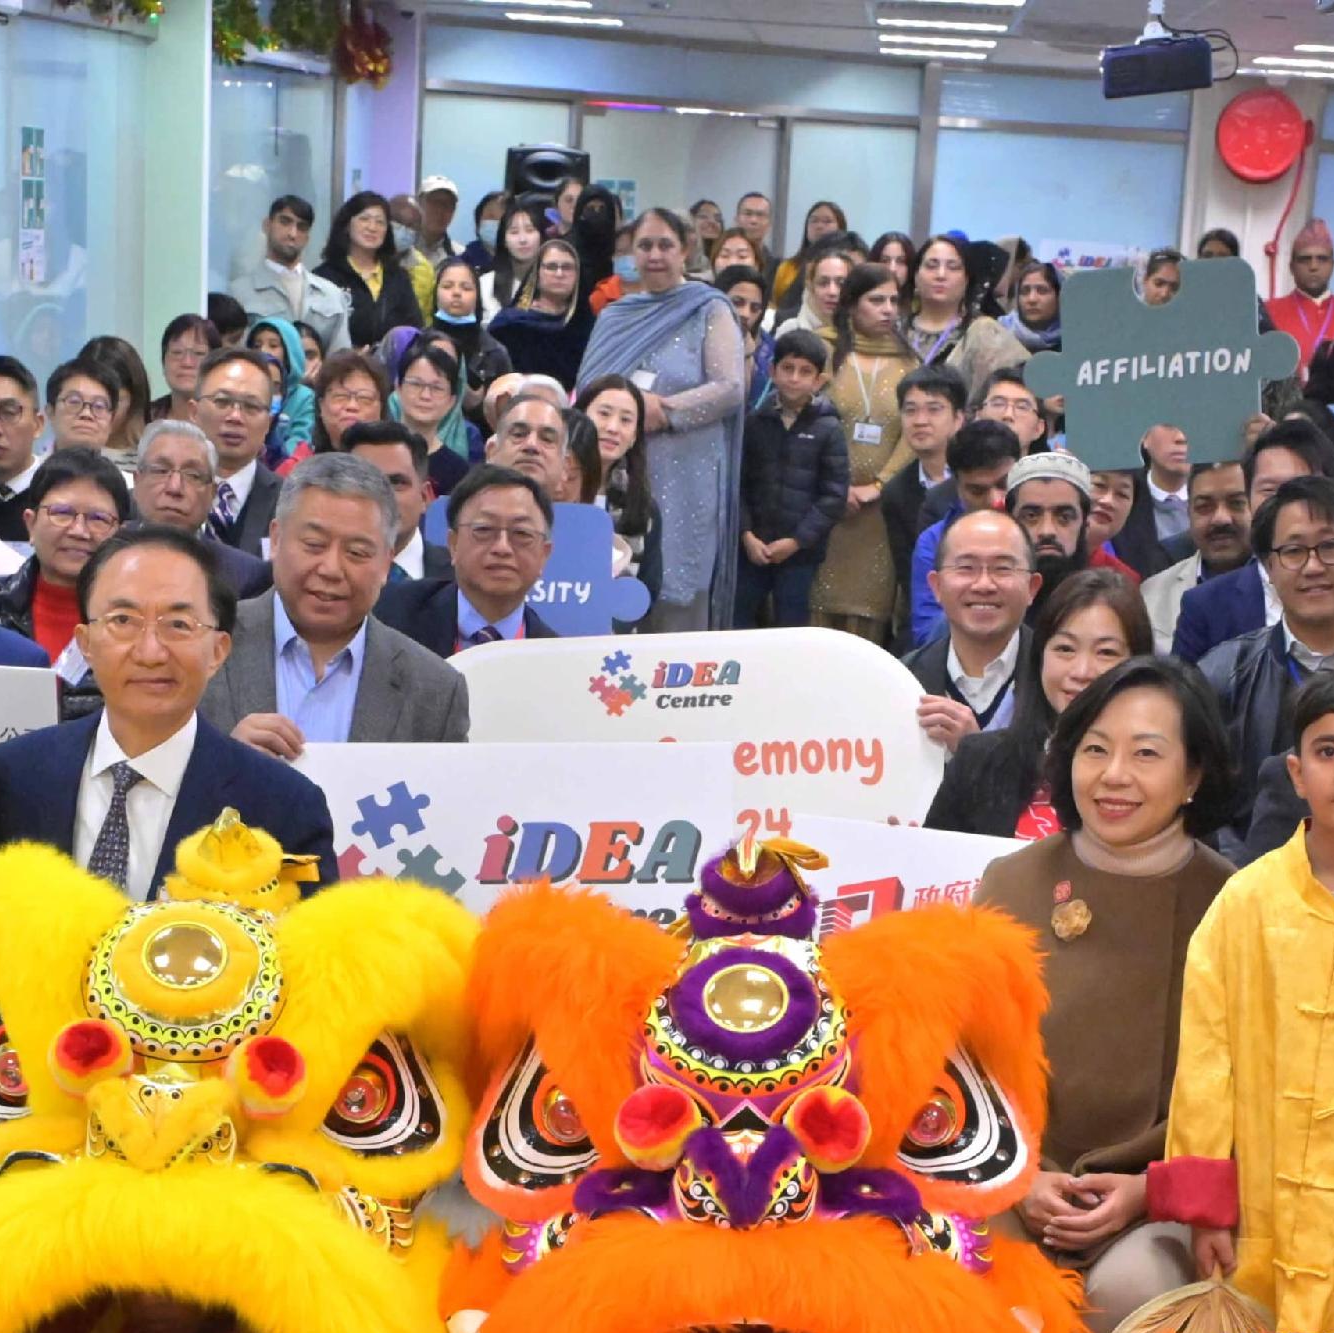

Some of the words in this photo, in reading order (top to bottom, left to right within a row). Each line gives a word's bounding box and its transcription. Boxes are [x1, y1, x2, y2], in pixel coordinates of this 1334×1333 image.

[1076, 348, 1252, 387] AFFILIATION
[525, 579, 591, 604] SITY
[651, 660, 741, 689] iDEA
[655, 692, 733, 710] Centre
[733, 738, 884, 786] emony
[737, 807, 792, 838] 24
[475, 814, 702, 885] iDEA
[913, 878, 981, 911] 政府
